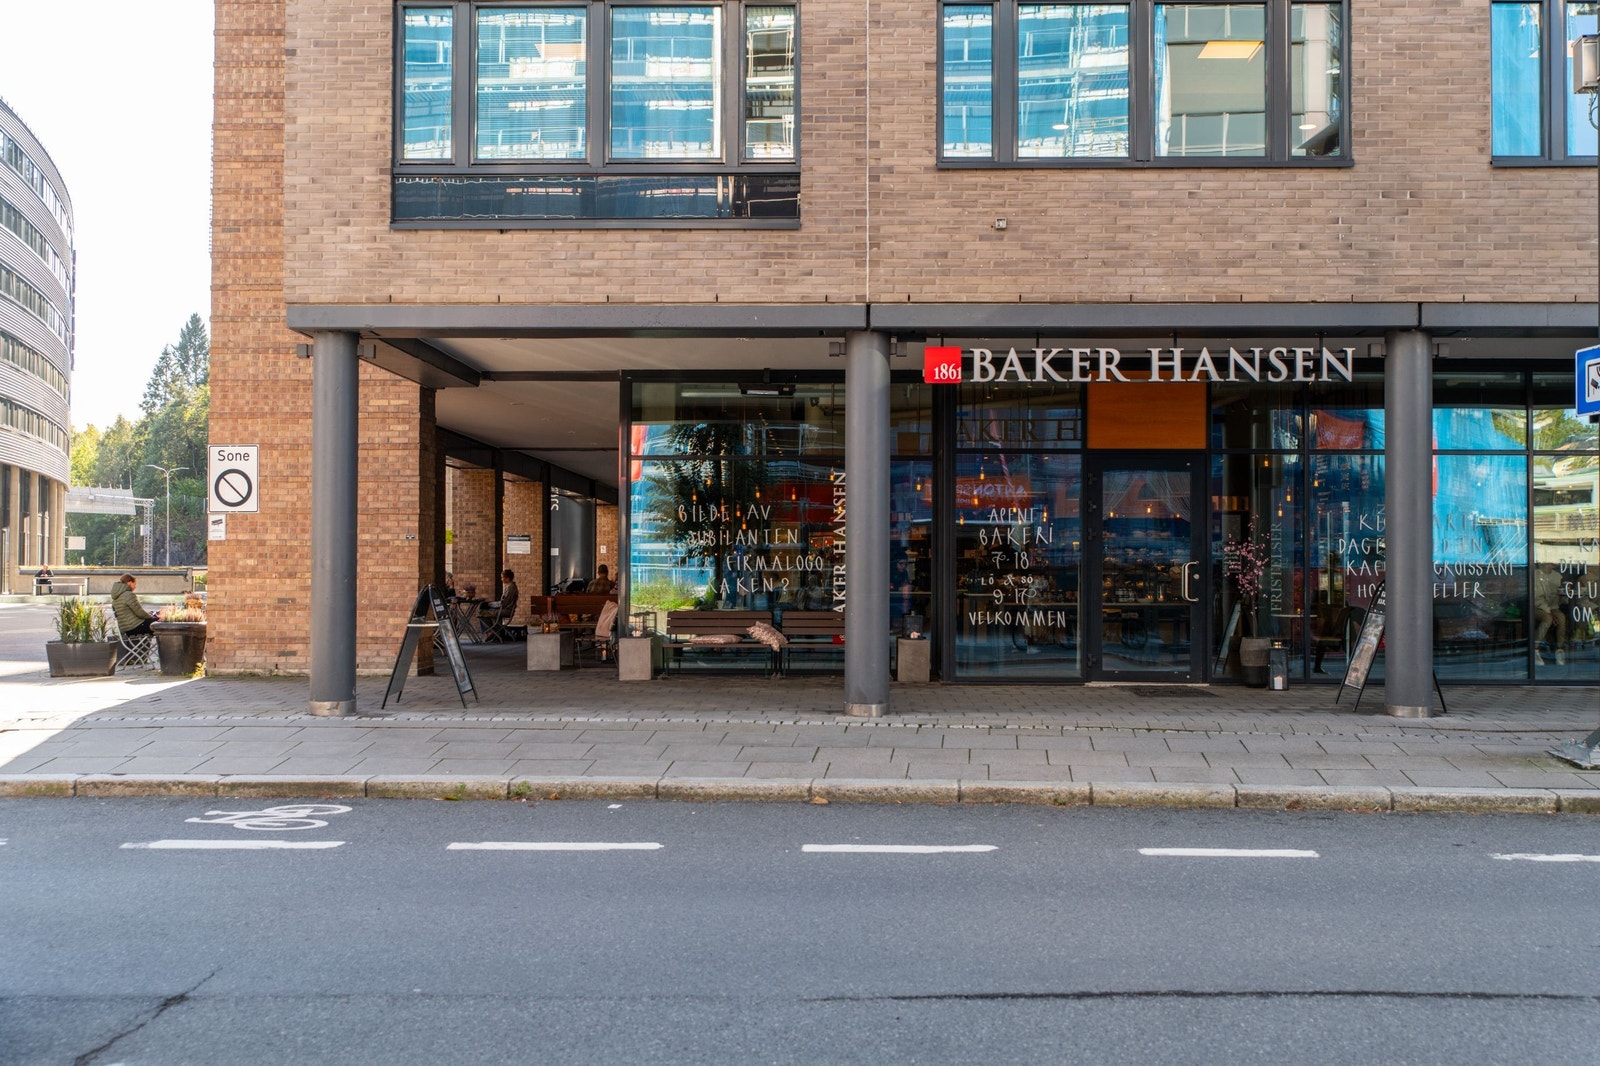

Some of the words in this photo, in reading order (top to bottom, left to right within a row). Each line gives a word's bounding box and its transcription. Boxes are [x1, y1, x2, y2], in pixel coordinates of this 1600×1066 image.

[933, 362, 962, 380] 1861
[970, 347, 1131, 383] BAKER
[1147, 347, 1356, 384] HANSEN
[217, 449, 250, 462] Sone
[678, 502, 731, 523] BILDE
[747, 503, 772, 521] AV
[832, 471, 846, 555] HANSEN
[979, 522, 1054, 546] BAKERI
[726, 554, 824, 573] FIRMALOGO
[1270, 522, 1282, 612] FRISTELSER
[832, 564, 846, 613] AKER
[1433, 582, 1486, 600] ELLER
[968, 611, 1067, 629] VELKOMMEN
